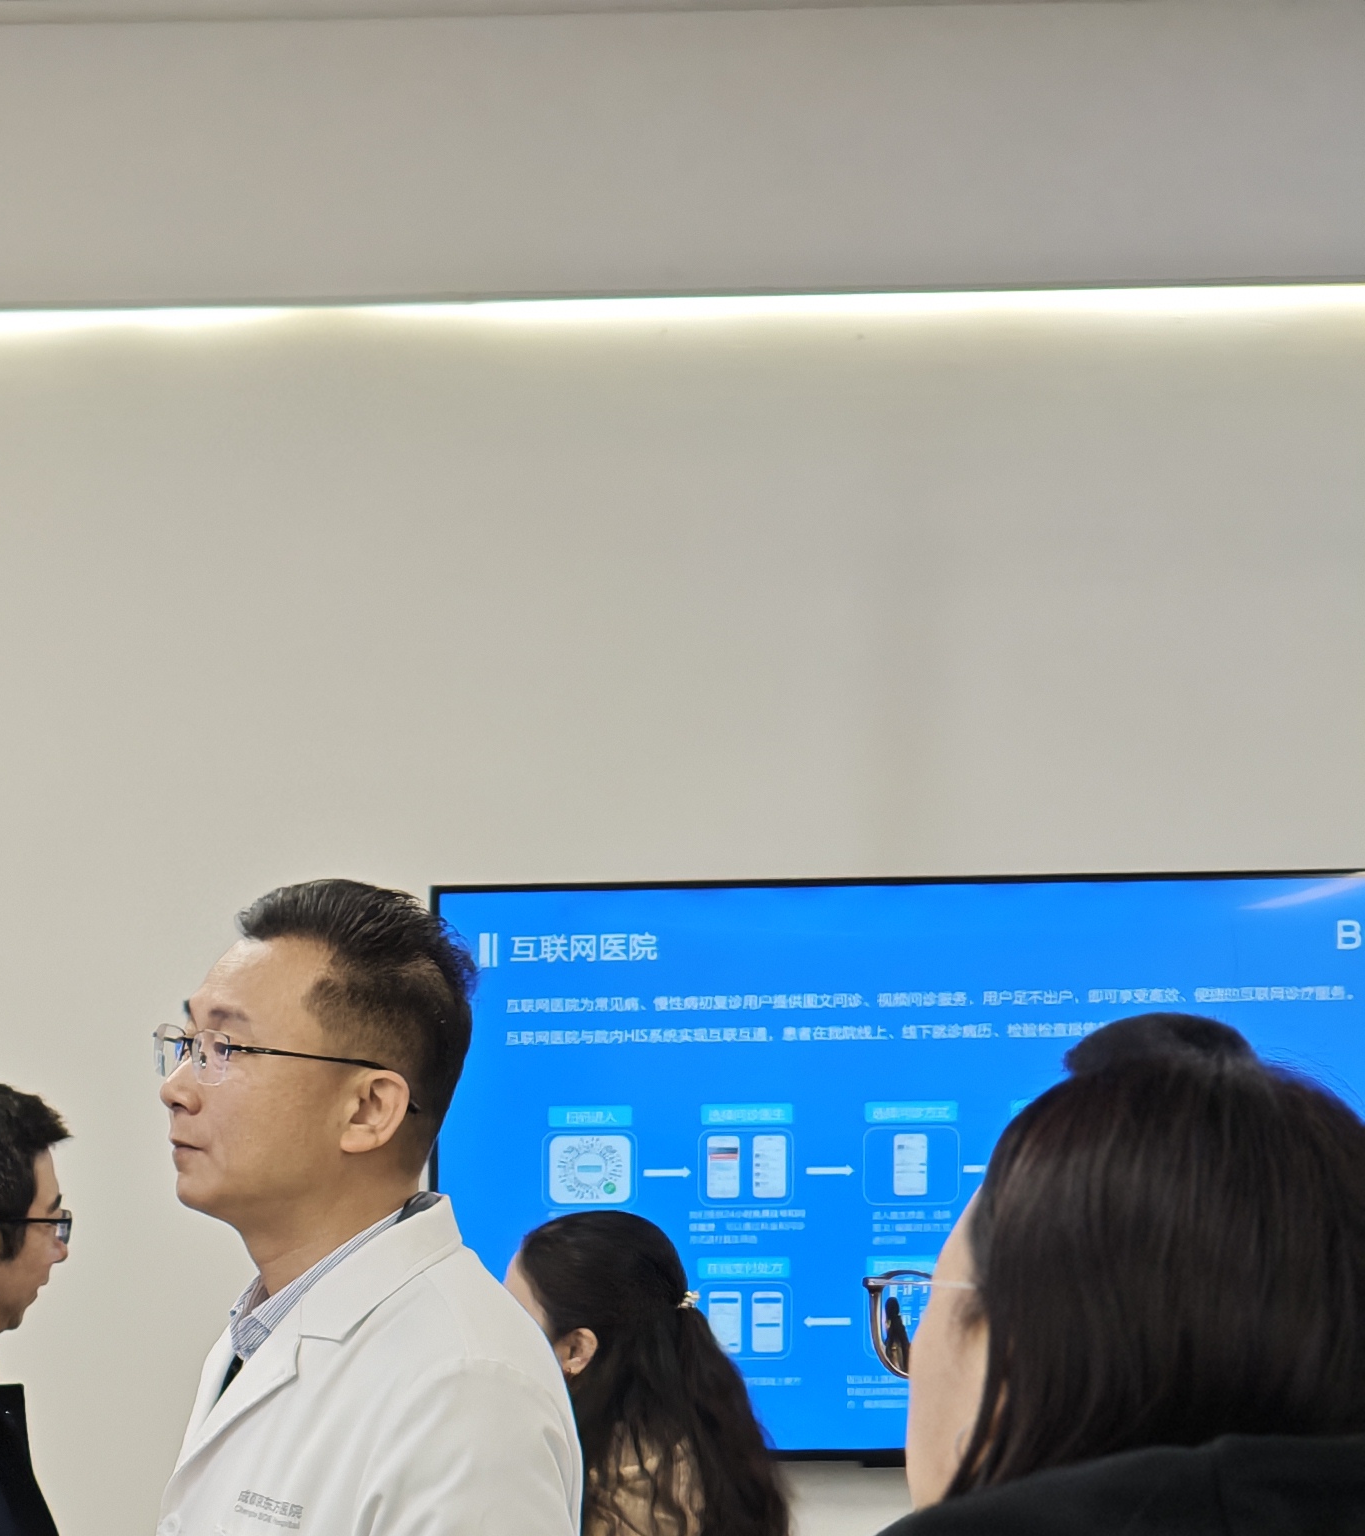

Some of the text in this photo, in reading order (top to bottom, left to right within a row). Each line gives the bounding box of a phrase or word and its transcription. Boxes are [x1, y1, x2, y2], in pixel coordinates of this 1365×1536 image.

[509, 931, 658, 963] 互联网医院
